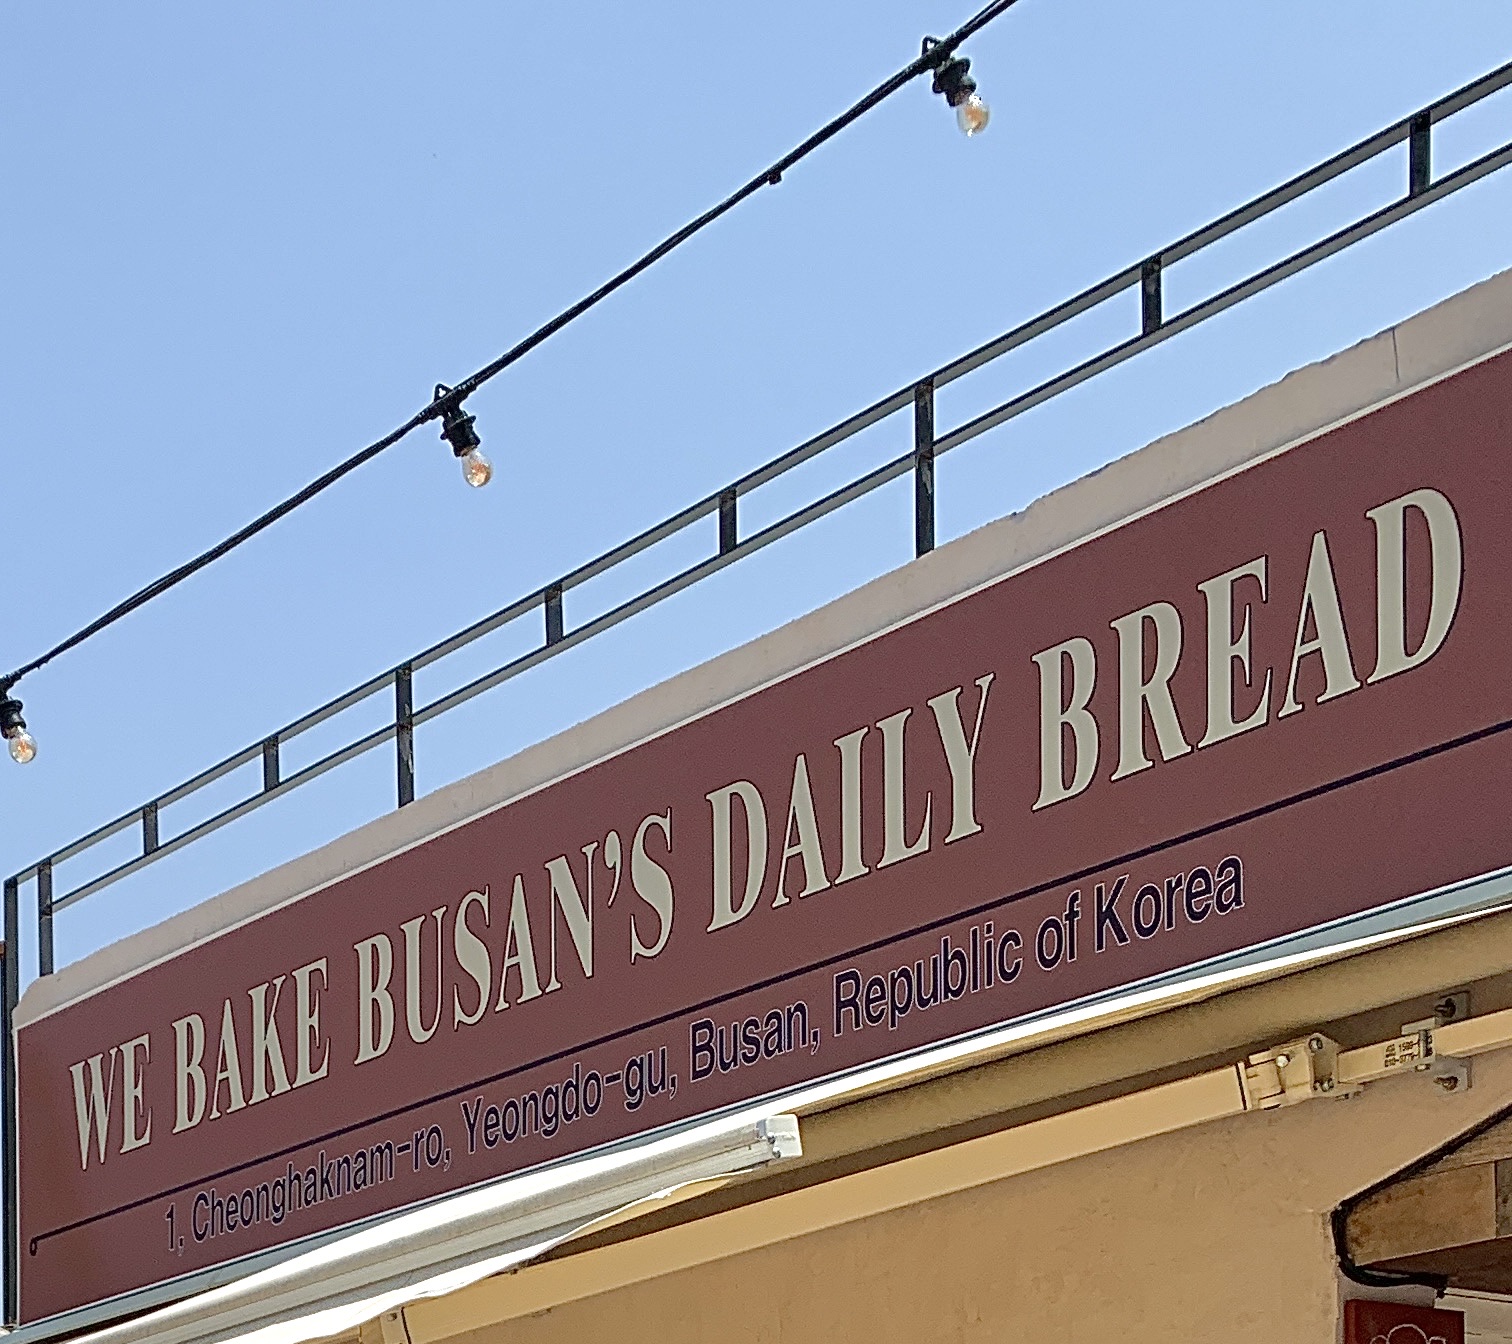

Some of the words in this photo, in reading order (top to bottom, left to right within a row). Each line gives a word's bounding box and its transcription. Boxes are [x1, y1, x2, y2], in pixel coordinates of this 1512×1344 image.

[70, 1033, 152, 1170] WE
[172, 958, 330, 1134] BAKE
[354, 808, 675, 1065] BUSAN'S
[706, 673, 996, 933] DAILY
[1031, 486, 1465, 812] BREAD
[164, 1203, 185, 1256] 1,
[191, 1120, 452, 1244] Cheonghaknam-ro,
[461, 1043, 678, 1150] Yeongdo-gu,
[689, 1000, 821, 1083] Busan,
[833, 920, 1024, 1038] Republic
[1035, 890, 1083, 972] of
[1094, 854, 1245, 953] Korea
